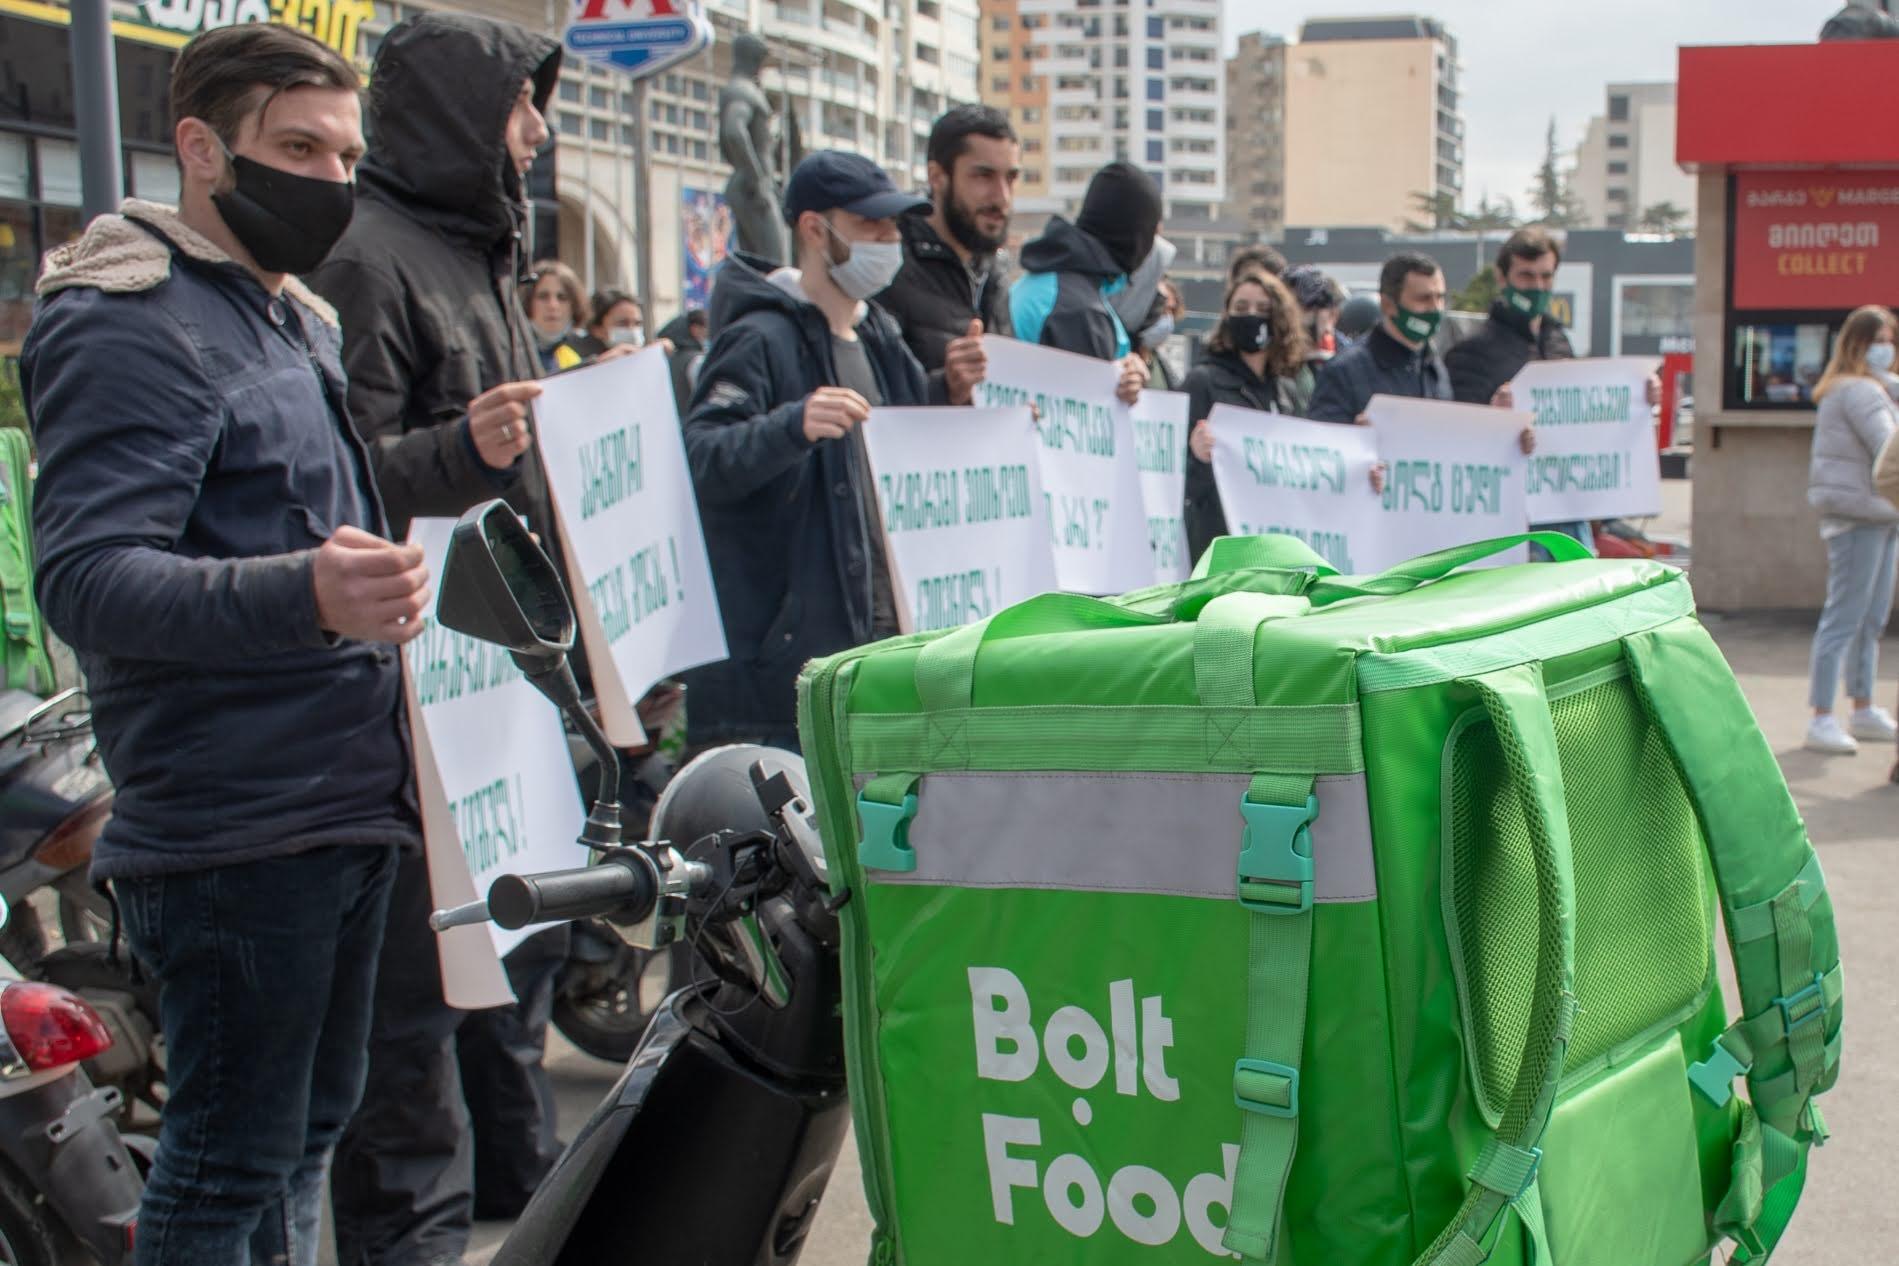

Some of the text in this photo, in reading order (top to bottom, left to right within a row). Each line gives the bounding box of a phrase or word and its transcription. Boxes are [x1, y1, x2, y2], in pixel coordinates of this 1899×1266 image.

[1777, 251, 1867, 276] COLLECT
[967, 966, 1181, 1101] Bolt
[982, 1112, 1243, 1260] Food
